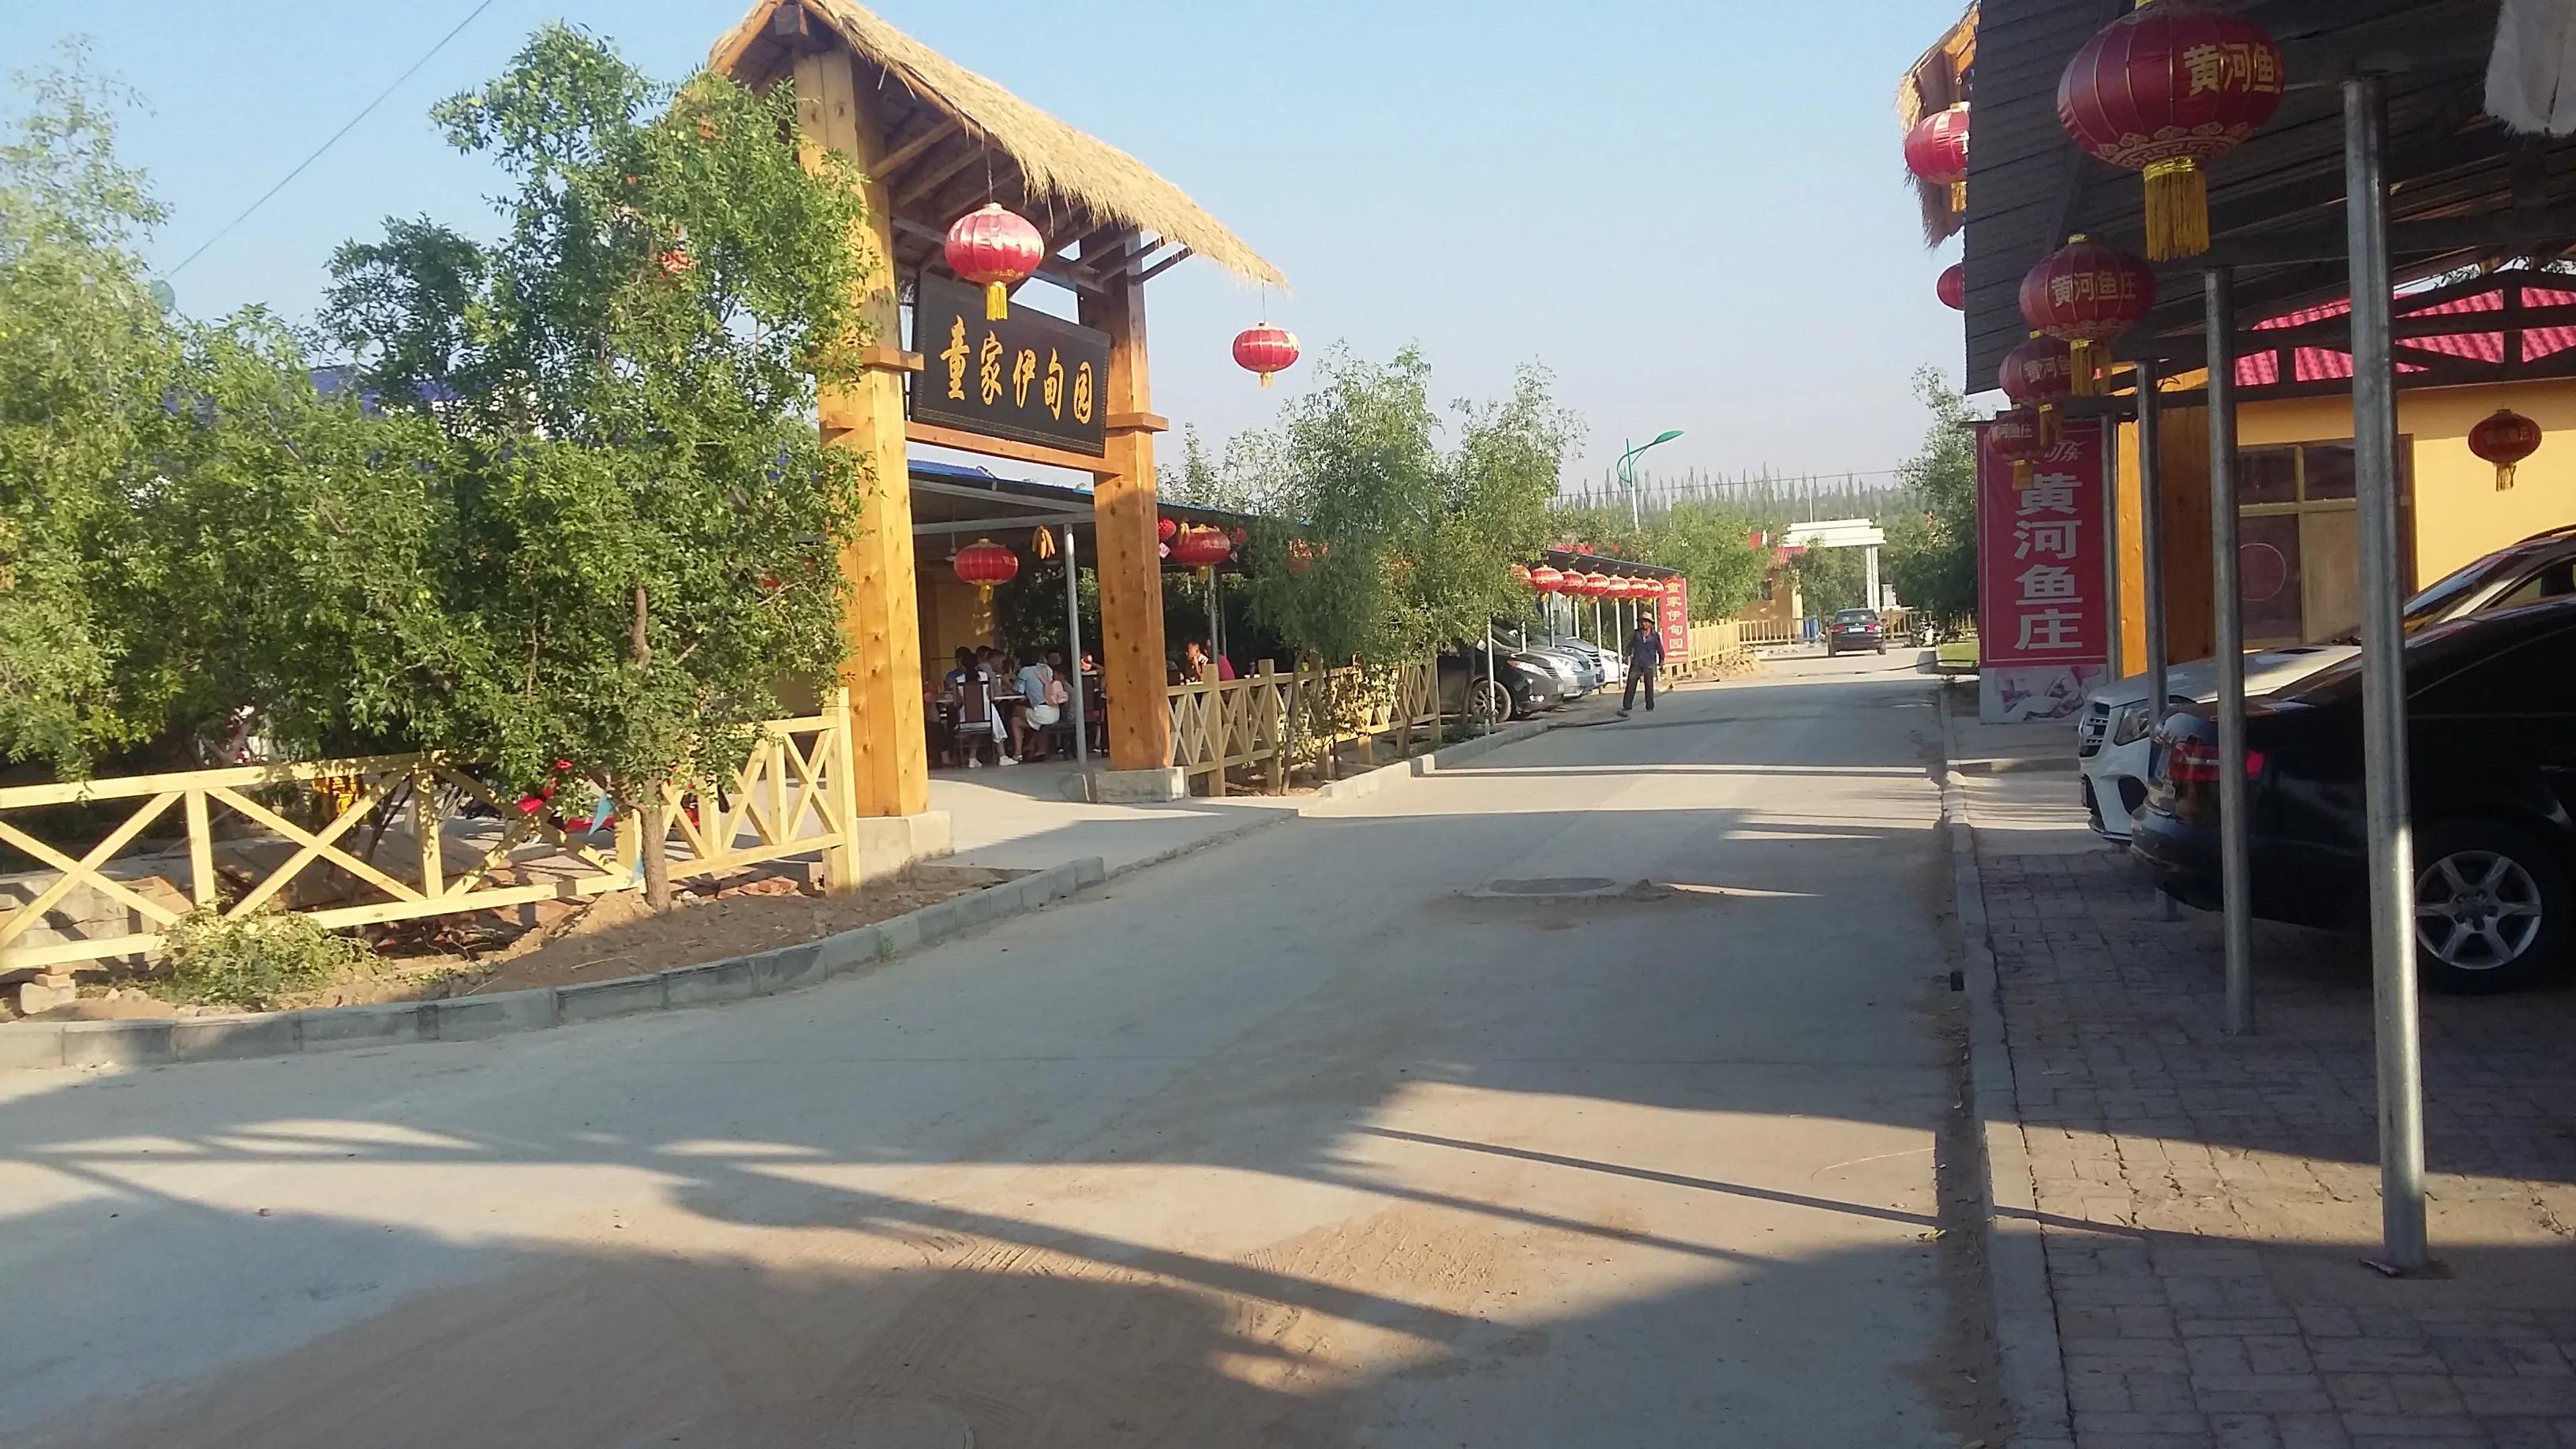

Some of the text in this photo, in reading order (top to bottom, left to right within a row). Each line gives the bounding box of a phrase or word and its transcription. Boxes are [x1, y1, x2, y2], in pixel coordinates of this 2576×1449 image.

[2052, 271, 2136, 308] 黄河鱼庄
[940, 315, 1092, 425] 童家伊甸园
[2024, 355, 2071, 384] 黄河鱼
[2012, 473, 2084, 650] 黄河鱼庄
